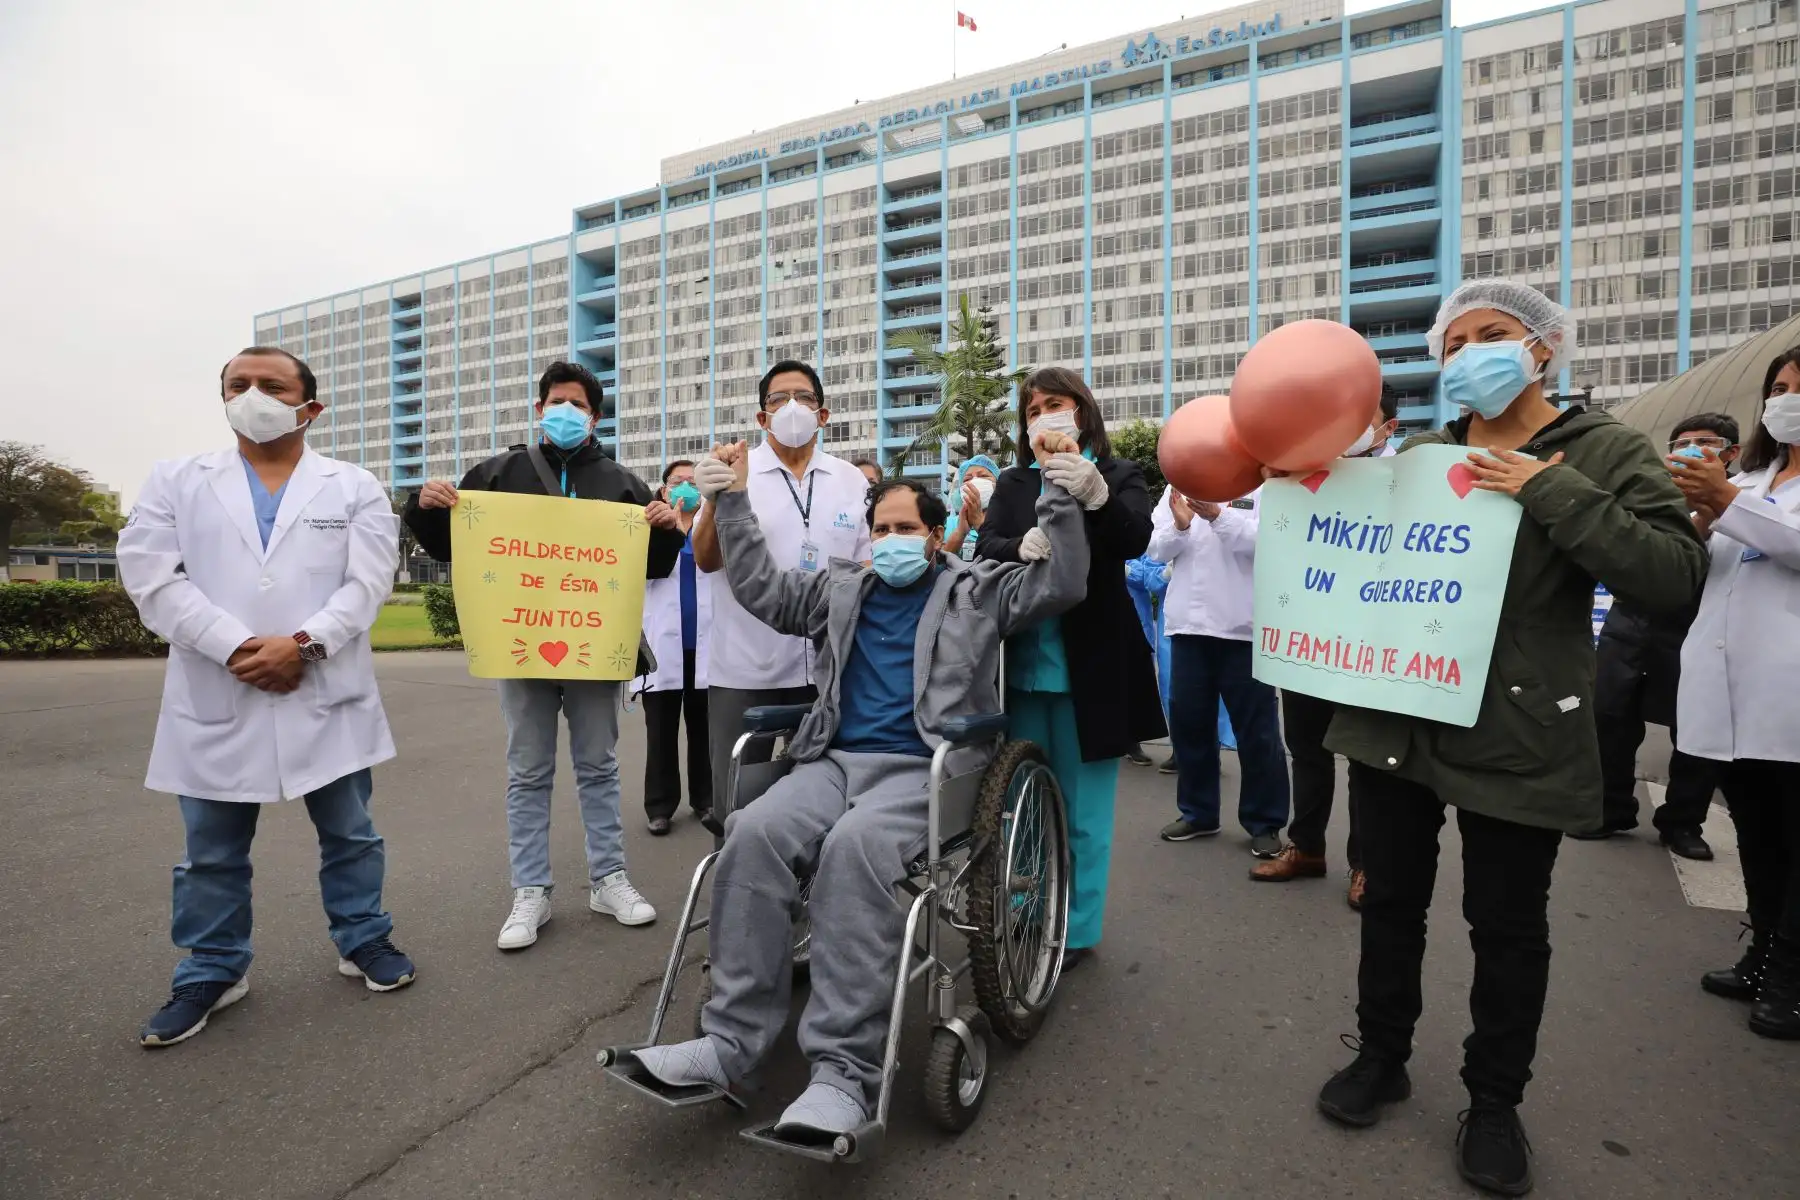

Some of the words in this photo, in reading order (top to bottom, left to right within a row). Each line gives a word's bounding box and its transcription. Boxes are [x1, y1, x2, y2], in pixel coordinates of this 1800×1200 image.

[1176, 12, 1281, 54] EsSalud
[488, 536, 618, 565] SALDREMOS
[1306, 511, 1394, 554] MIKITO
[1403, 522, 1471, 554] ERES
[520, 573, 545, 589] DE
[560, 573, 599, 593] ÉSTA
[1305, 566, 1336, 593] UN
[1359, 579, 1463, 603] GUERRERO
[502, 607, 602, 628] JUNTOS
[1261, 626, 1281, 652] TU
[1286, 631, 1375, 674] FAMILIA
[1382, 647, 1399, 674] TE
[1404, 652, 1461, 687] AMA
